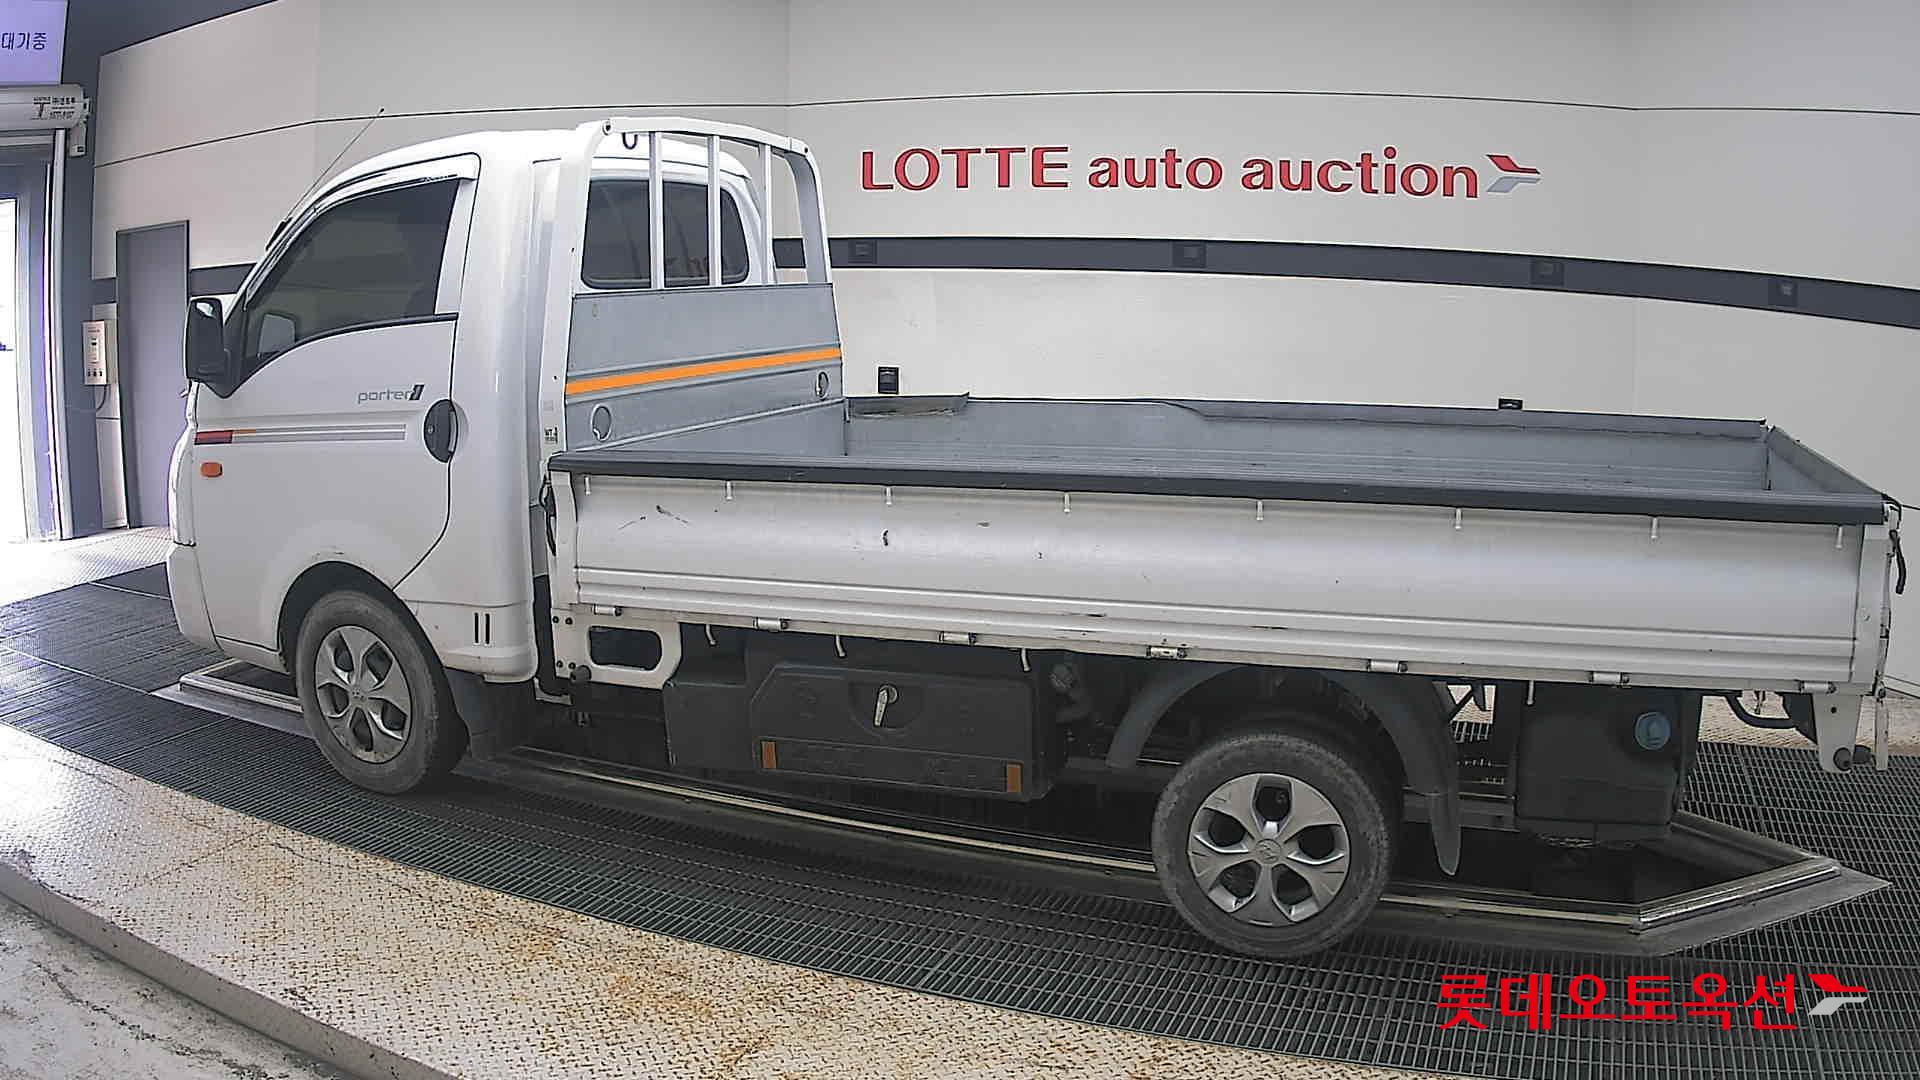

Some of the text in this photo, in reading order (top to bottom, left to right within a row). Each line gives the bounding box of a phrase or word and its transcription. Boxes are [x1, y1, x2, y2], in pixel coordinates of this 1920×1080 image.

[1, 32, 47, 50] 대기중
[862, 146, 1478, 198] LOTTE auto auction
